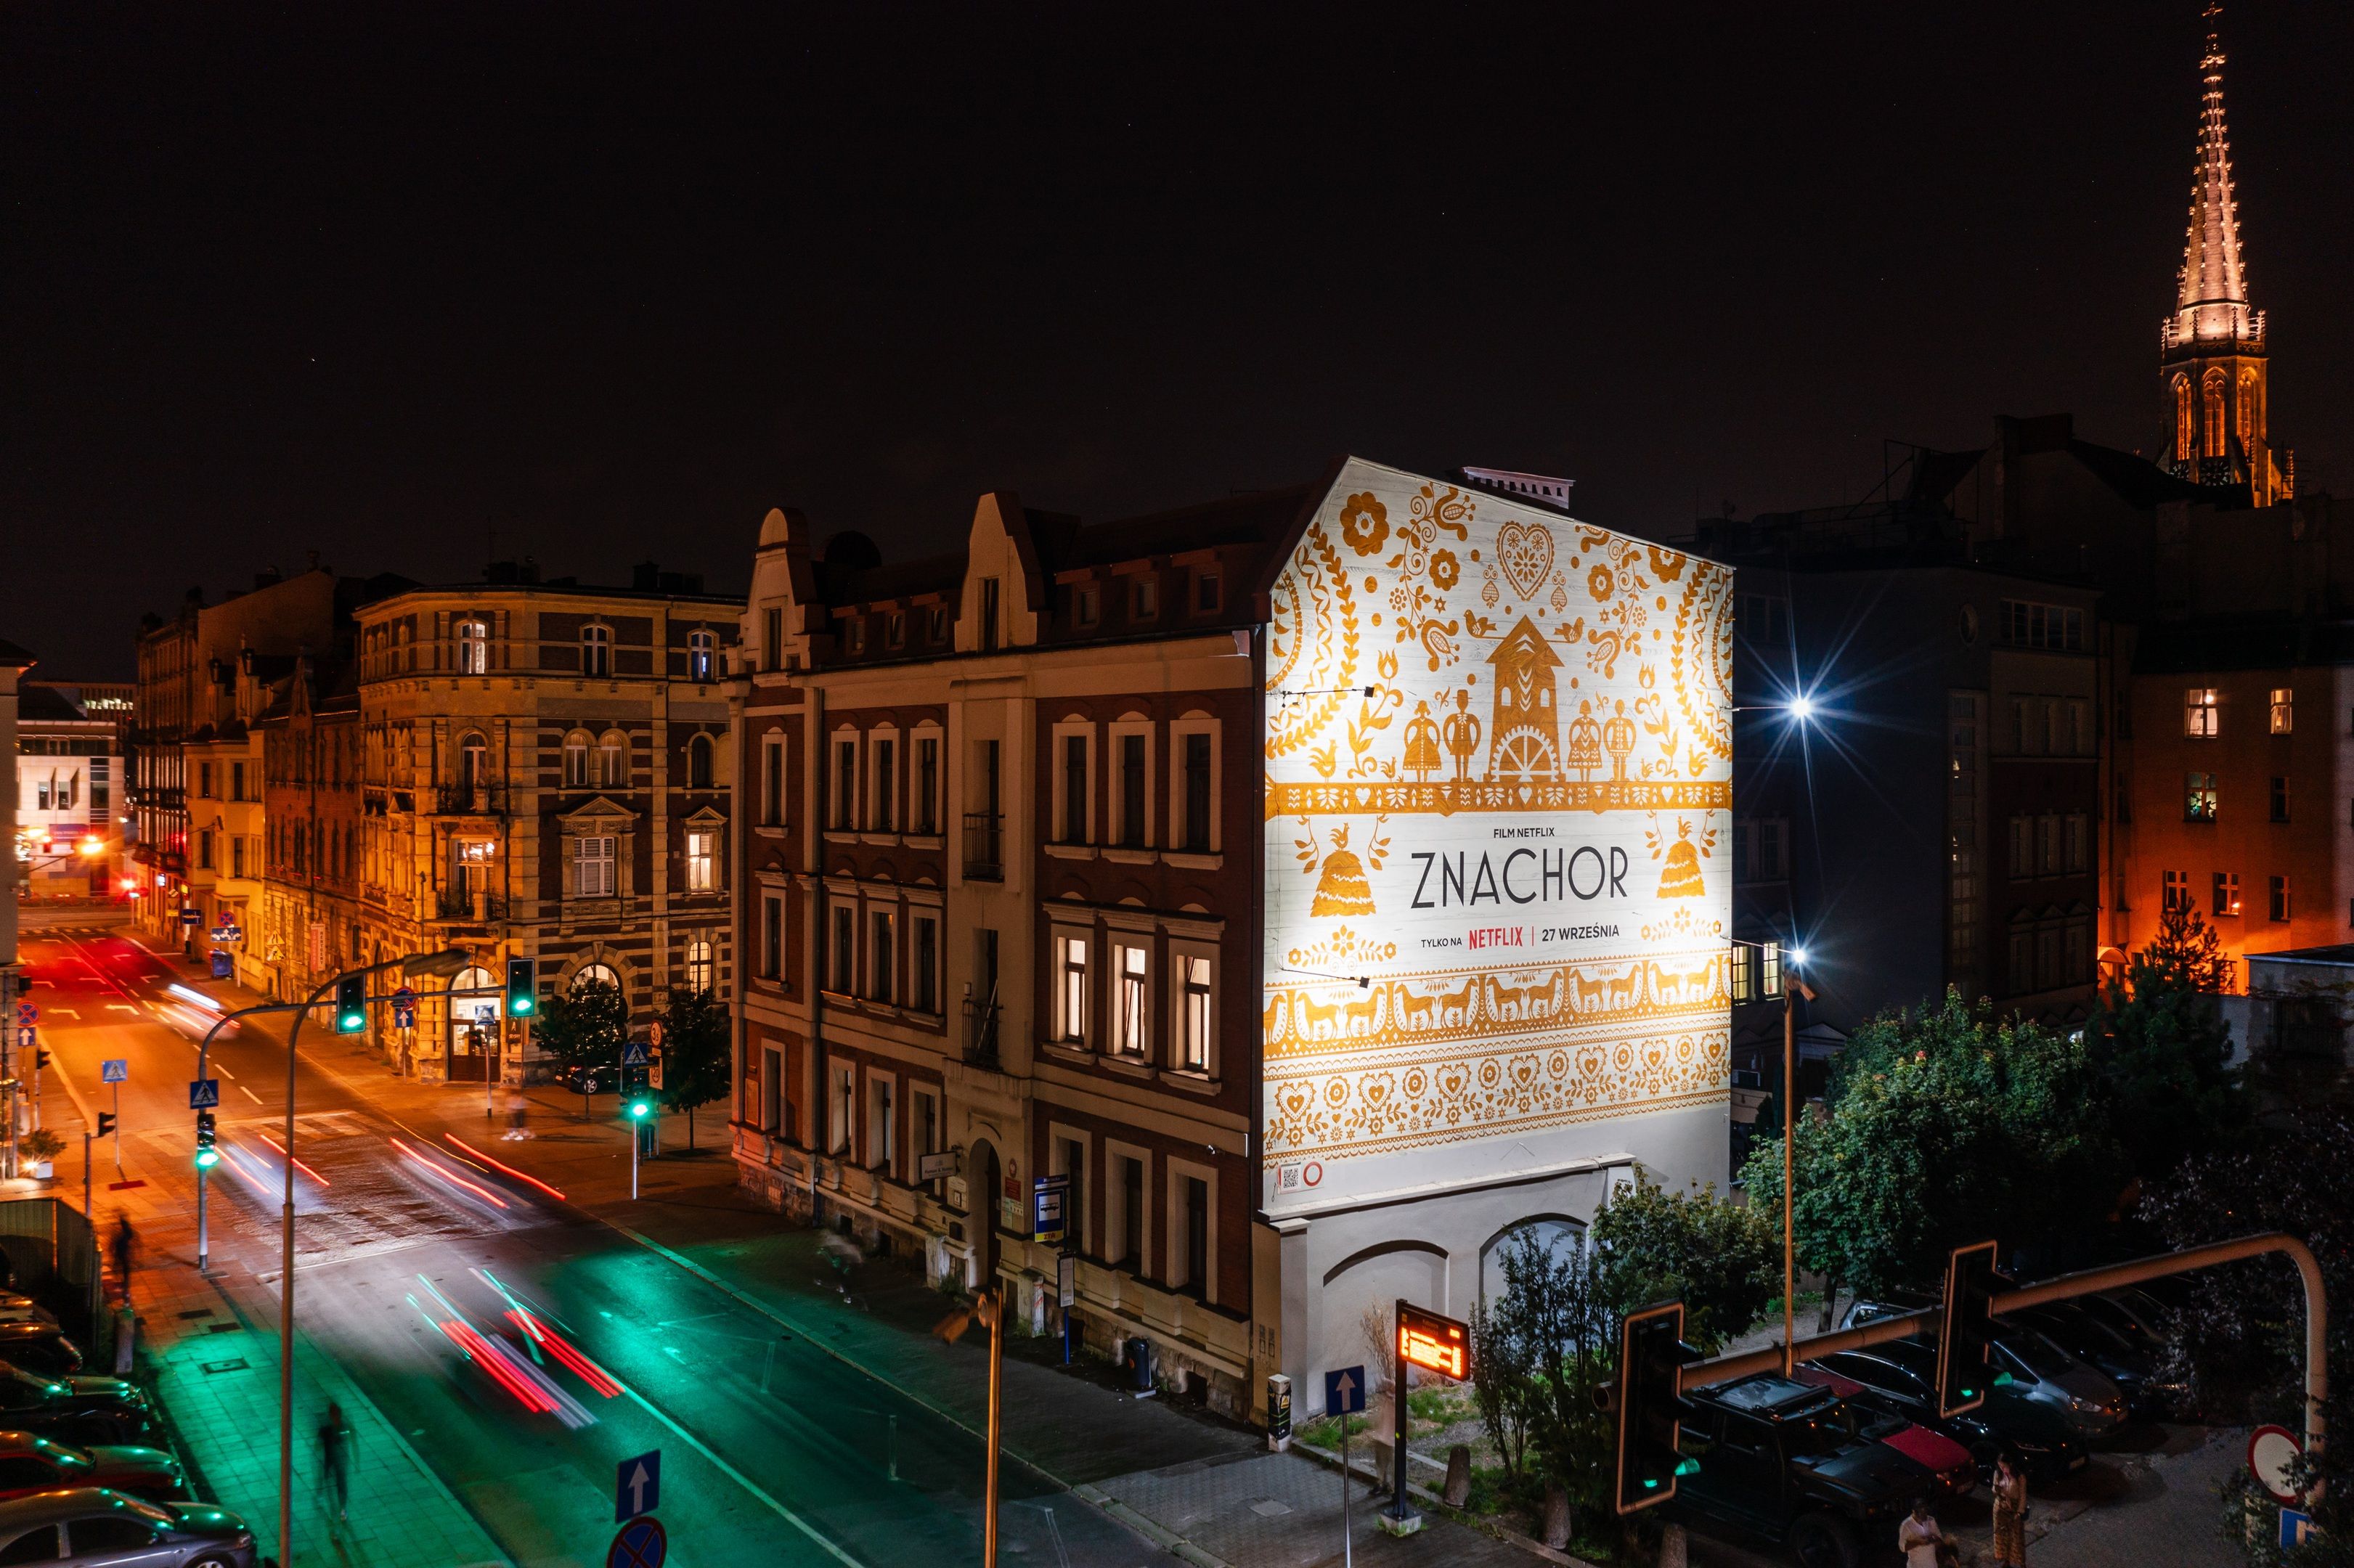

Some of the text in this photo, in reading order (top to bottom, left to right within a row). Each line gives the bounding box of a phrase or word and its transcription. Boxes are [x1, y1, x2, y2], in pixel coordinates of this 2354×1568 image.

[1494, 827, 1555, 838] FILM NETFLIX
[1410, 846, 1628, 909] ZNACHOR
[1421, 922, 1620, 950] TYLKO NA NETFLIX 27 WRZEŚNIA
